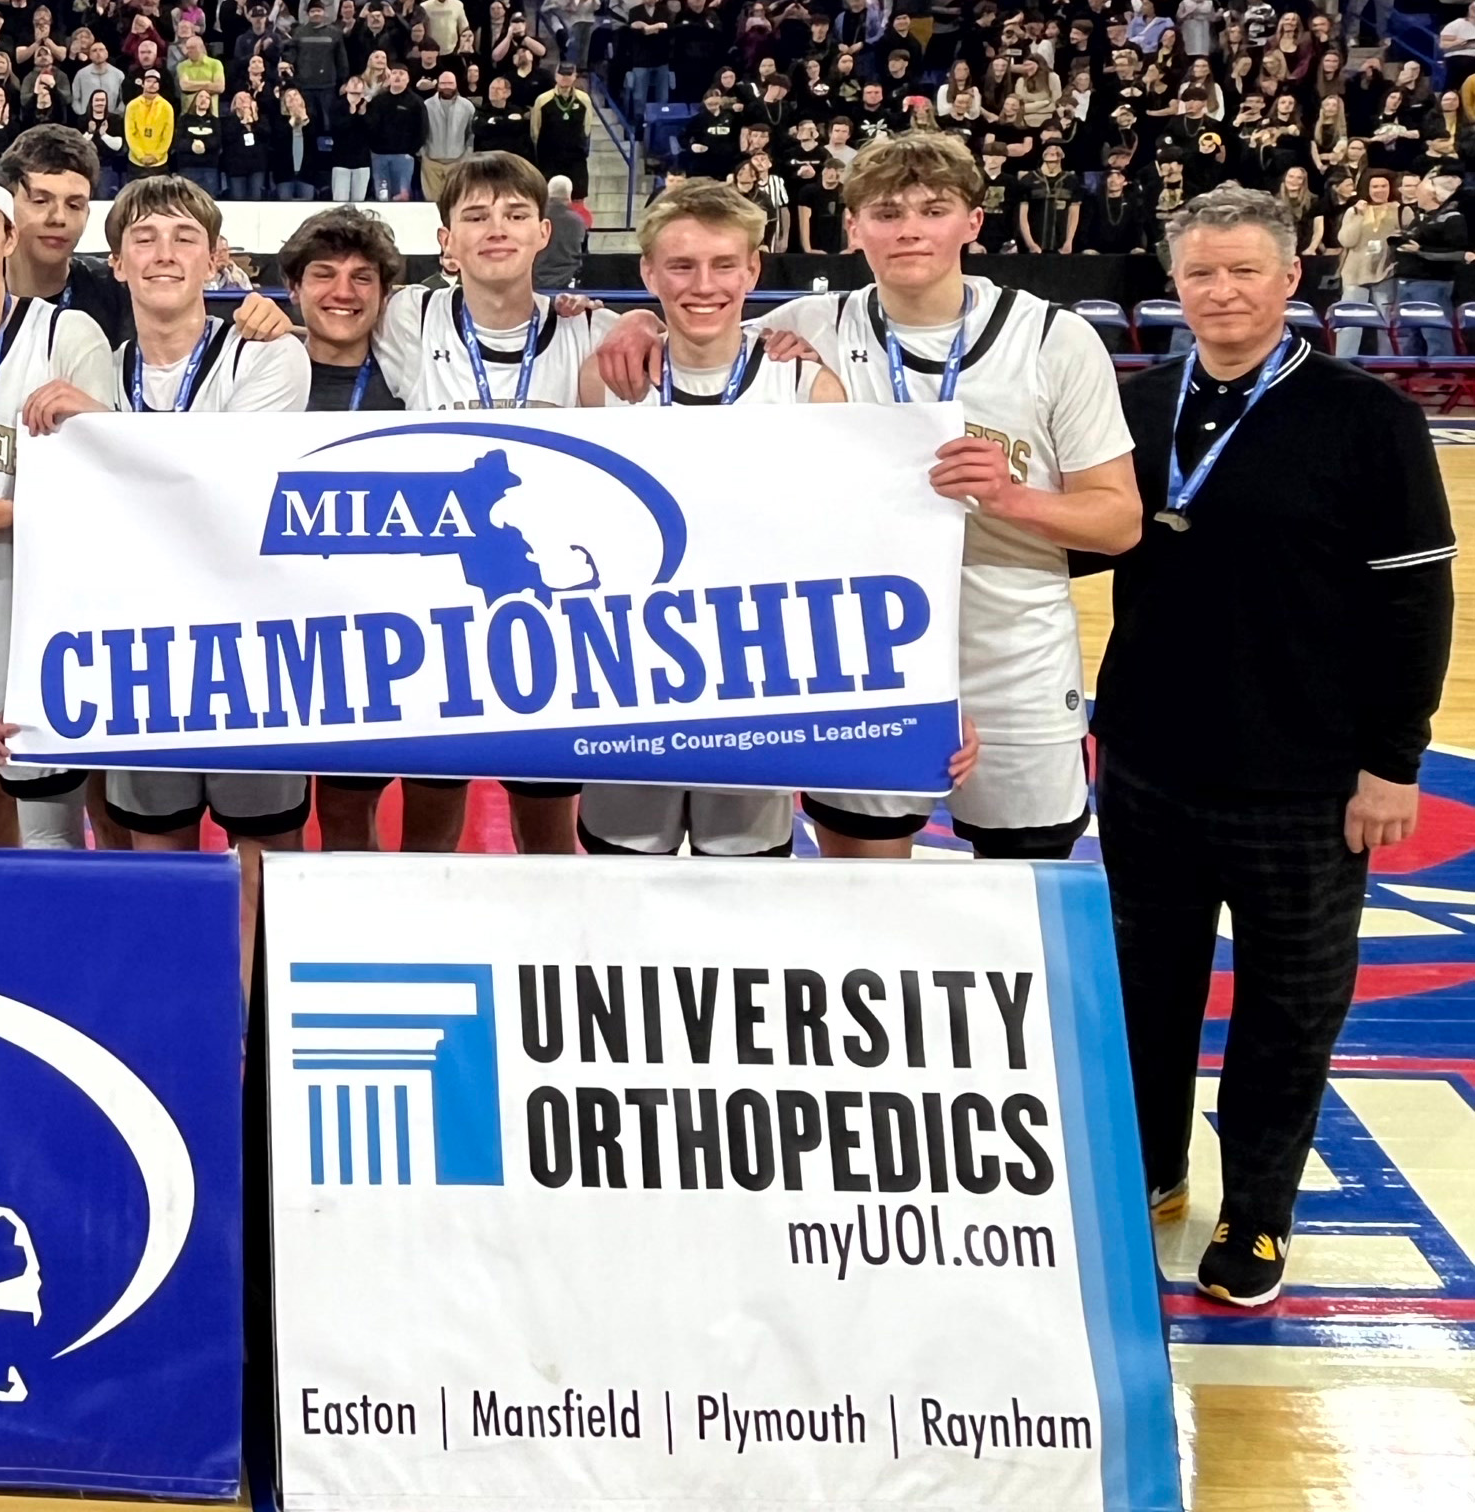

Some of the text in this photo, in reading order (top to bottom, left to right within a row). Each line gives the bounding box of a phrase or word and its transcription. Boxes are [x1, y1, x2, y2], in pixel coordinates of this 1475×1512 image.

[281, 490, 476, 537] MIAA
[41, 574, 931, 738] CHAMPIONSHIP
[574, 734, 665, 756] Growing
[671, 723, 806, 750] Courageous
[518, 964, 1033, 1069] UNIVERSITY
[526, 1085, 1055, 1196] ORTHOPEDICS
[788, 1203, 1056, 1280] myUOI.com
[301, 1387, 1093, 1459] Easton Mansfield Plymouth Raynham
